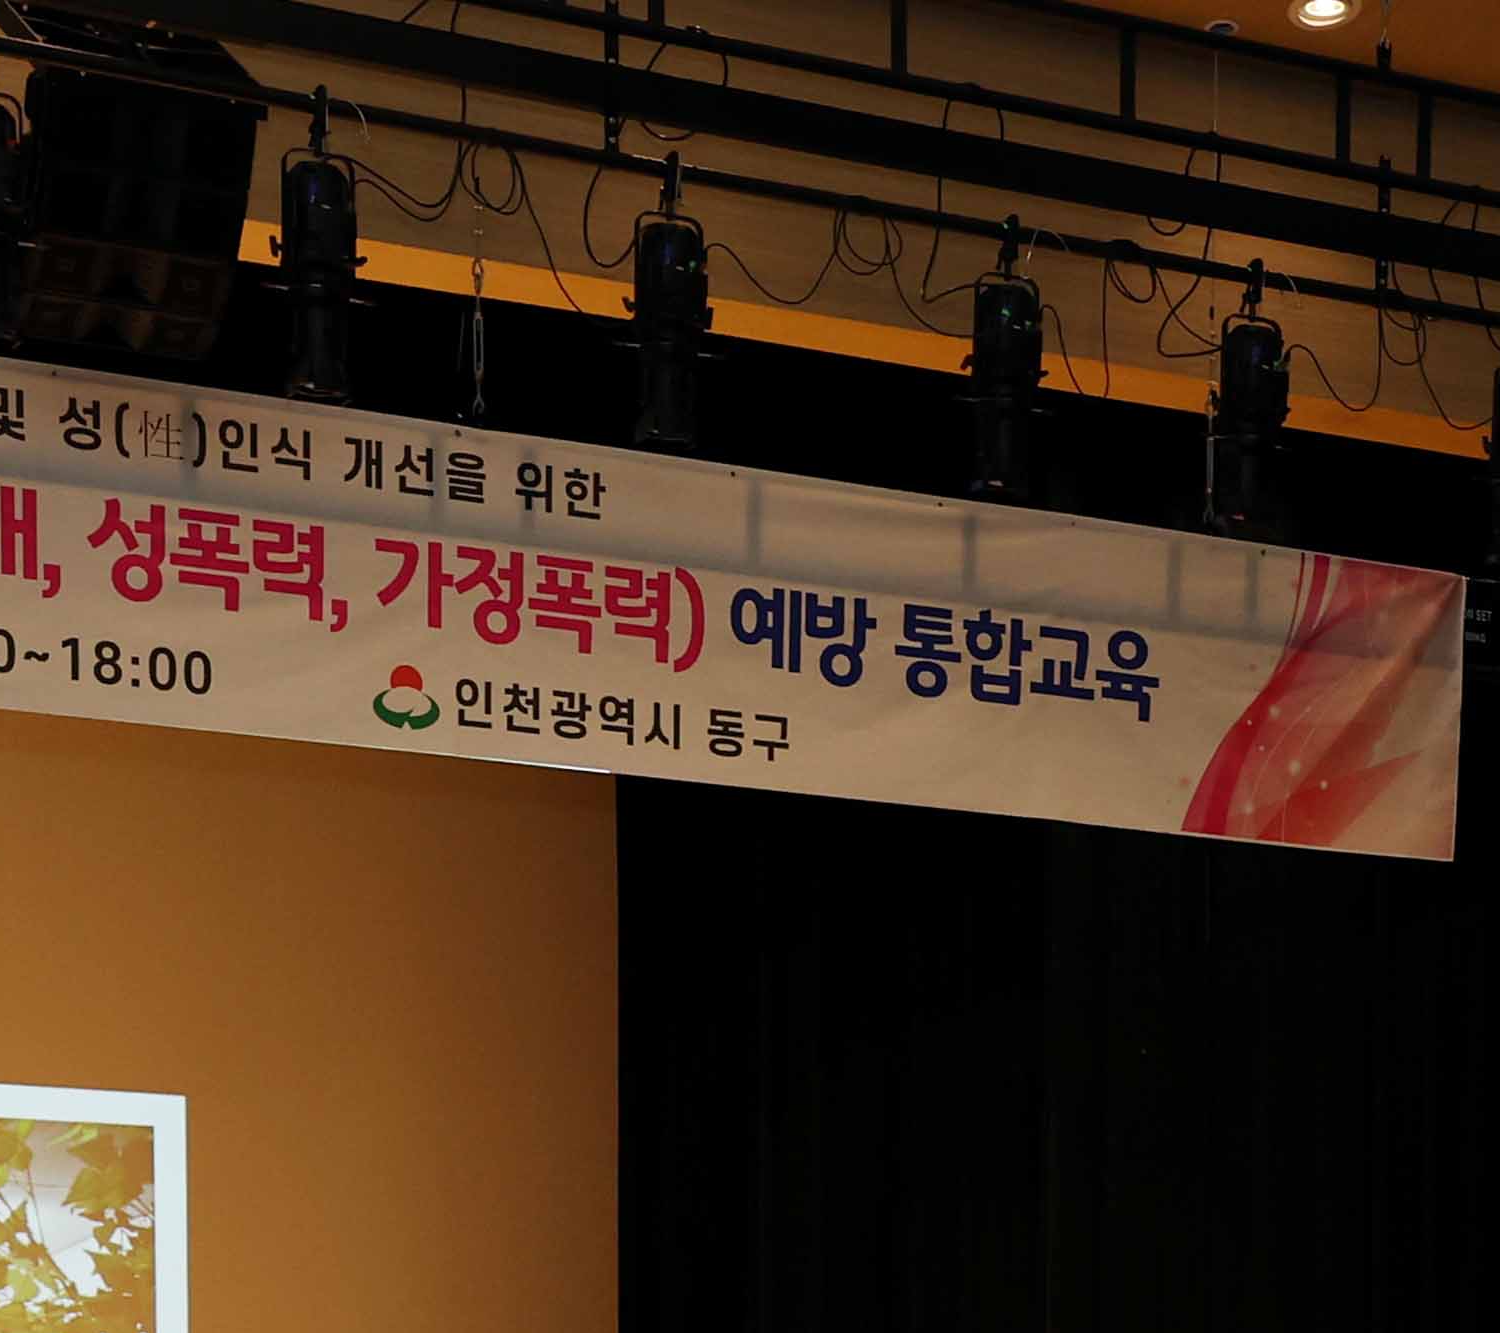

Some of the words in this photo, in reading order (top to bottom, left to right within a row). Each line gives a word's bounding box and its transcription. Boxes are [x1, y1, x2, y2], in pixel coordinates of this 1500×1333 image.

[344, 437, 486, 503] 개선을
[516, 462, 606, 520] 위한
[88, 498, 347, 632] 성폭력,
[376, 539, 704, 672] 가정폭력)
[731, 587, 877, 687] 예방
[897, 605, 1159, 721] 통합교육
[456, 679, 680, 749] 인천광역시
[708, 709, 789, 760] 동구
